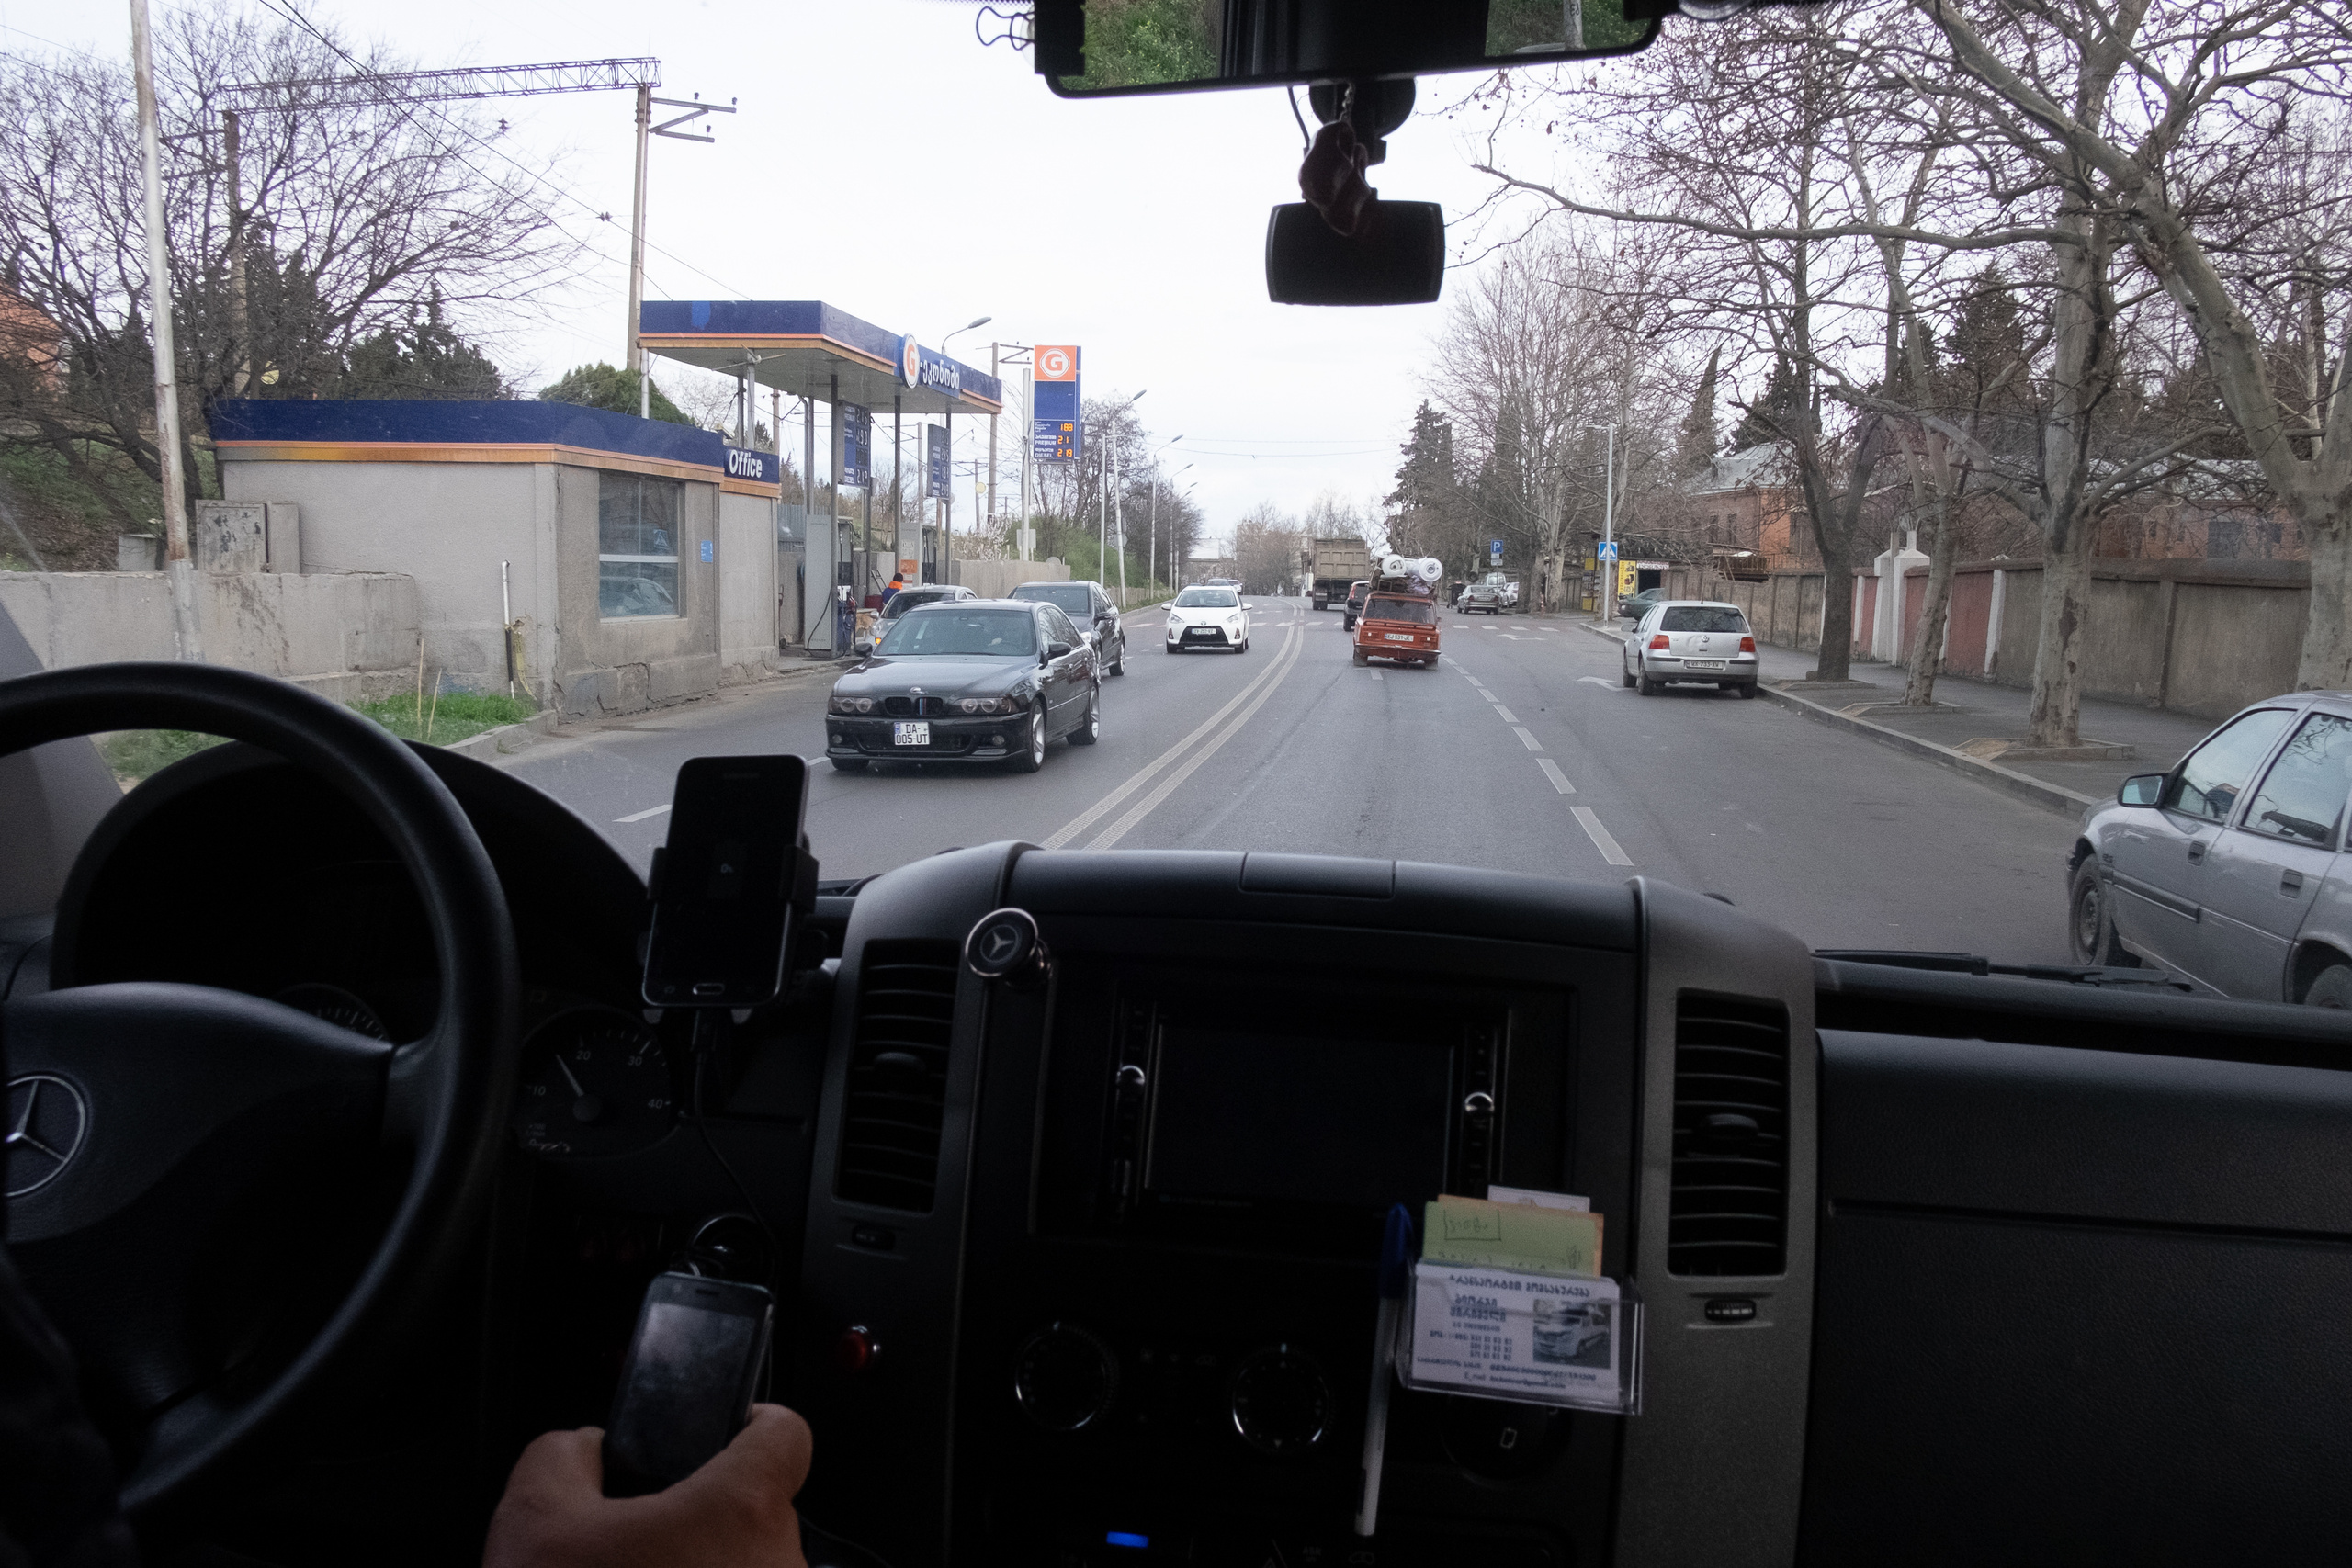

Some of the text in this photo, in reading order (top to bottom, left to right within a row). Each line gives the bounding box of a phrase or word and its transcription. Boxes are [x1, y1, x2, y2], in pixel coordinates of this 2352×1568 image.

[1045, 354, 1063, 371] G
[729, 449, 763, 478] Office
[1493, 541, 1501, 552] P
[896, 734, 928, 744] 005-UT
[575, 1050, 591, 1061] 20
[628, 1055, 643, 1066] 30
[532, 1085, 547, 1096] 10
[647, 1099, 663, 1109] 40
